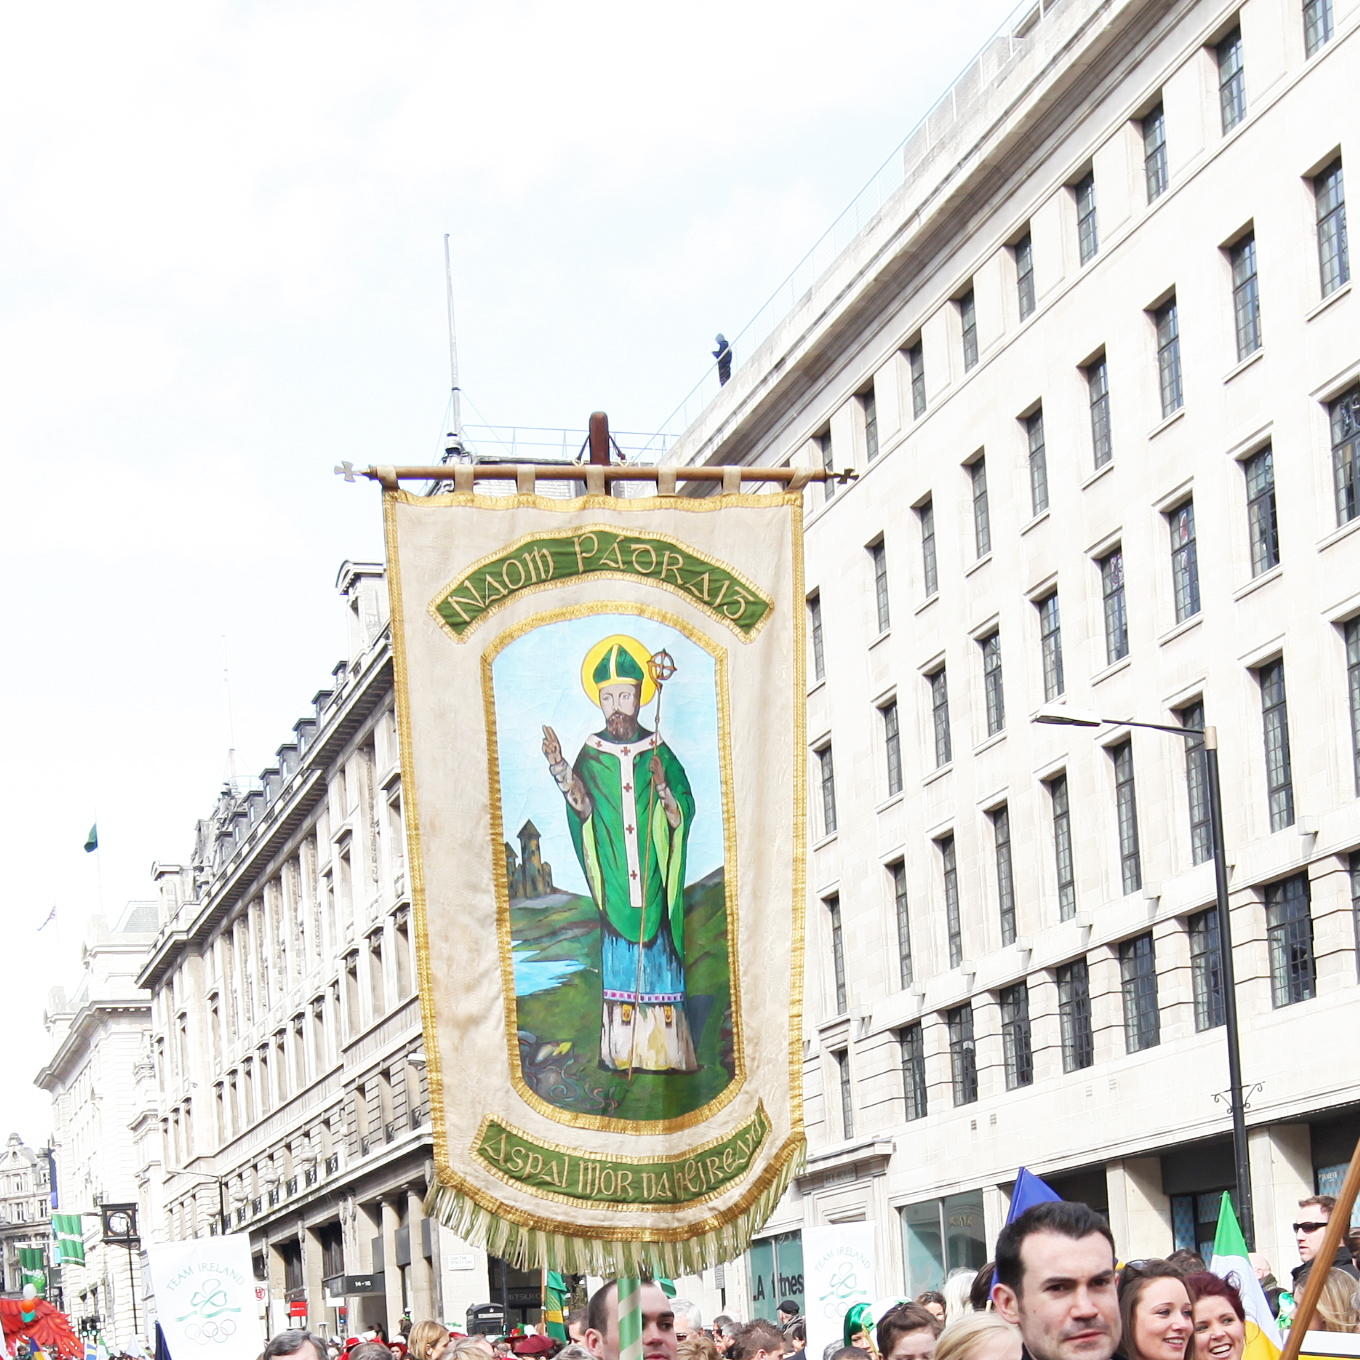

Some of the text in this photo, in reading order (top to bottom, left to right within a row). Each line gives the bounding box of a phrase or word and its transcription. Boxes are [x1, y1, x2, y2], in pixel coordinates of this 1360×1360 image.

[814, 1246, 871, 1273] TEAM IRELAND
[165, 1262, 245, 1292] TEAM IRELAND
